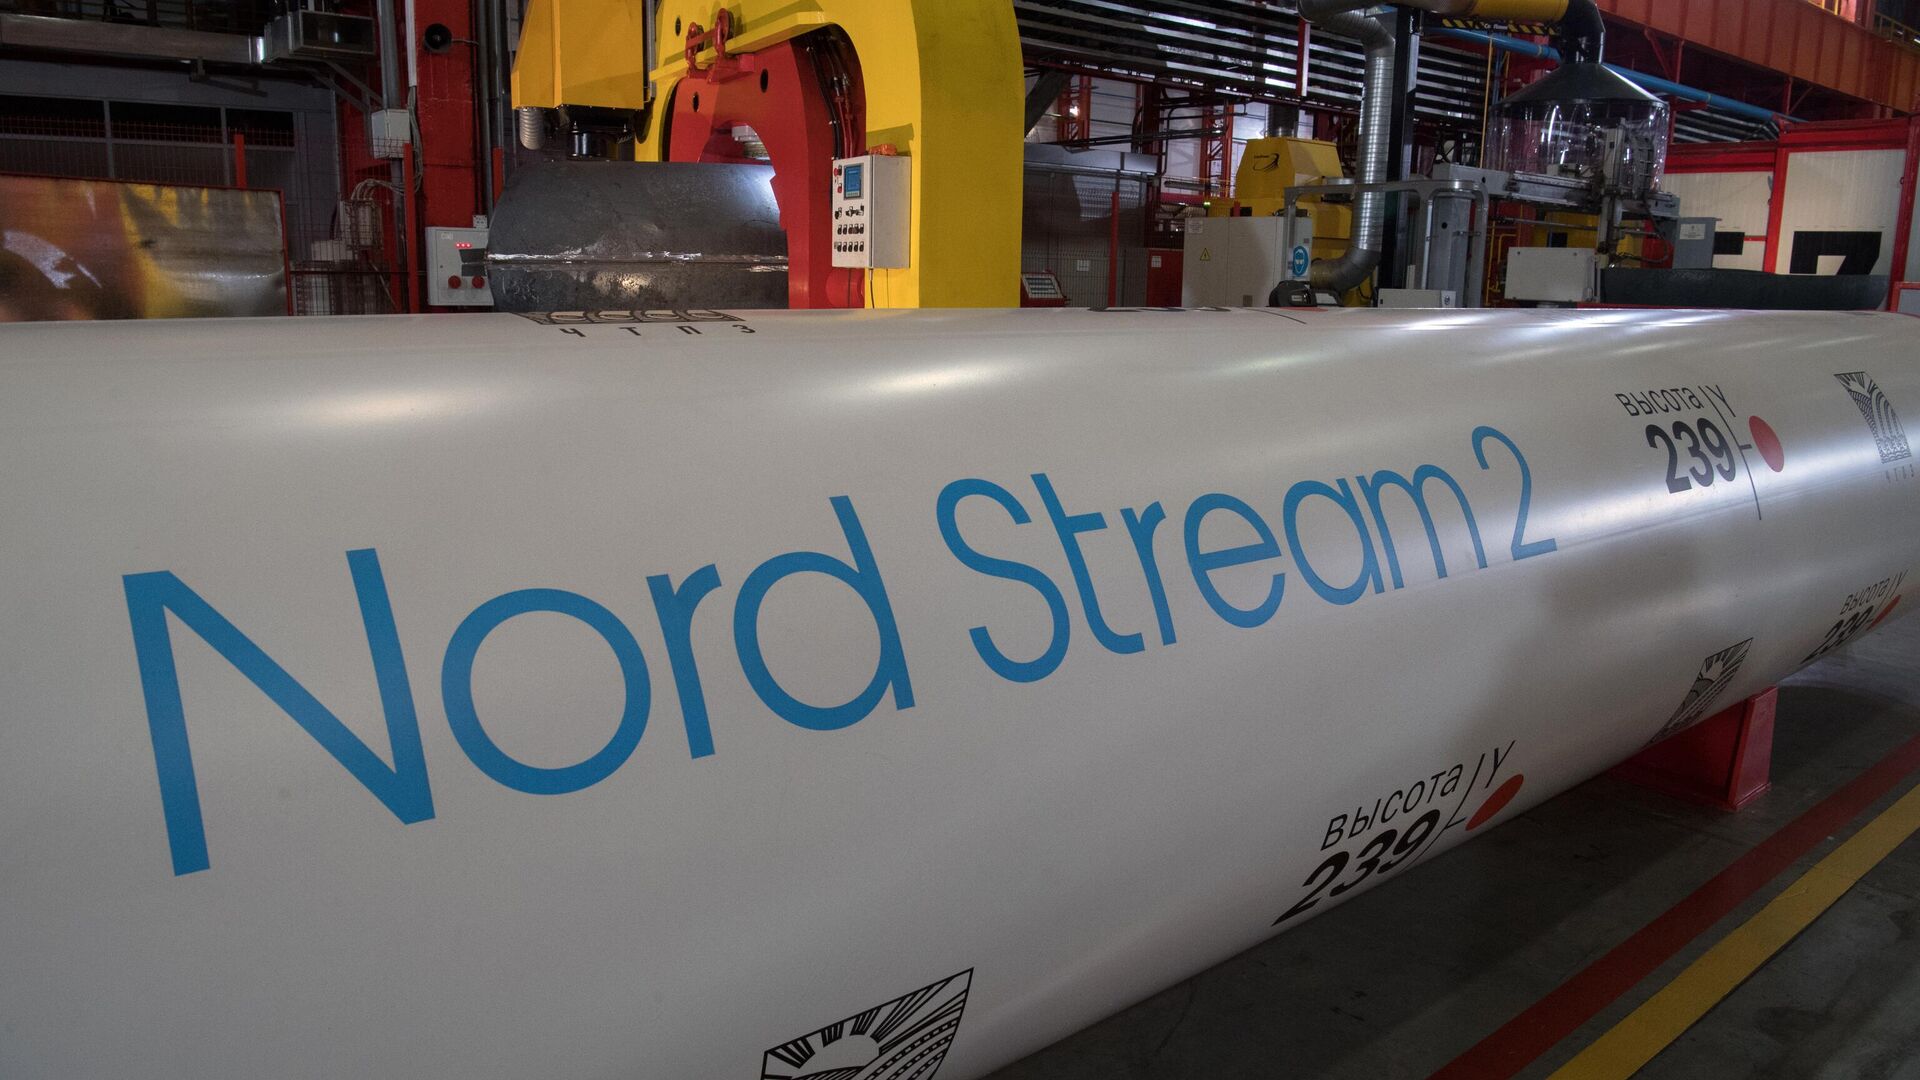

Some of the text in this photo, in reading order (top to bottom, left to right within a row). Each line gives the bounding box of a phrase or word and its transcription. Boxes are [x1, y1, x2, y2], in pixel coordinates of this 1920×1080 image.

[1644, 416, 1737, 495] 239
[123, 425, 1557, 876] Nord Stream 2
[1800, 605, 1875, 665] 239
[1271, 808, 1441, 927] 239
